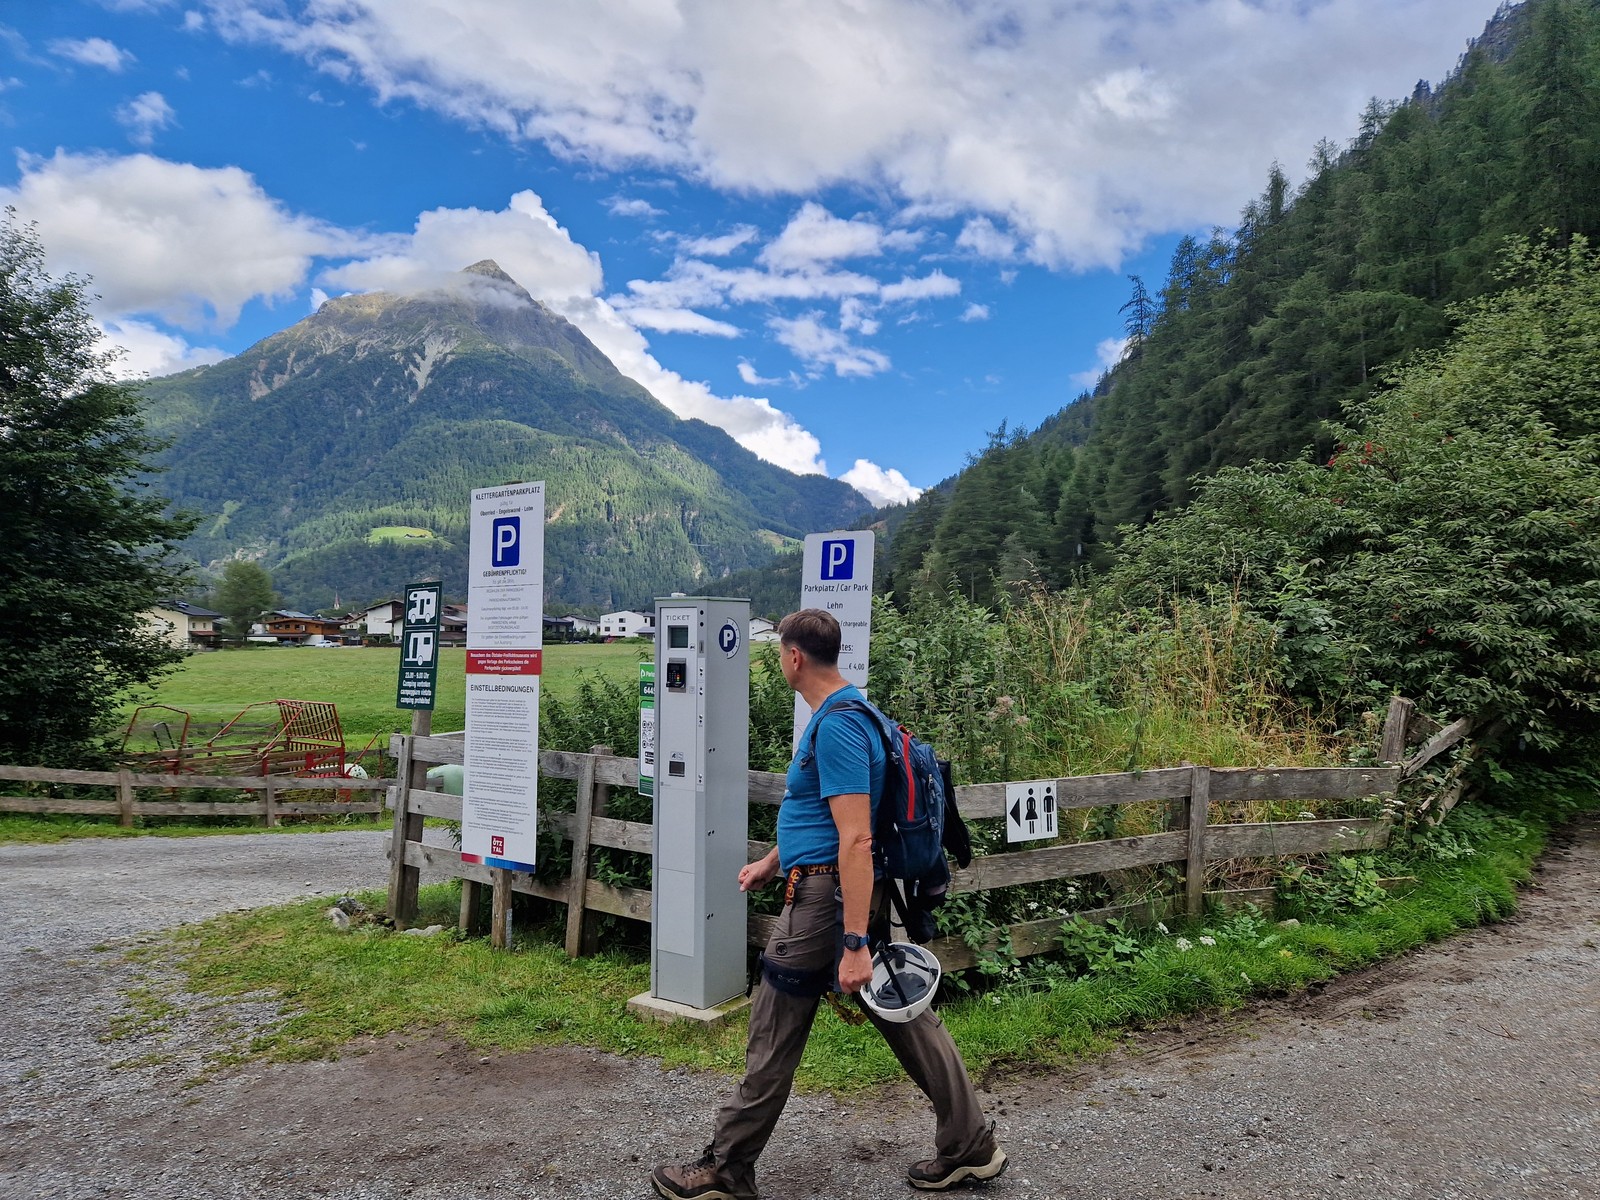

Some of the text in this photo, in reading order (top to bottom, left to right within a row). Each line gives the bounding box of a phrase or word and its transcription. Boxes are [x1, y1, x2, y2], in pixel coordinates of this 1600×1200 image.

[476, 487, 540, 500] KLETTERGARTENPARKPLATZ
[497, 525, 516, 562] P
[829, 543, 846, 577] P
[804, 584, 835, 593] Parkplatz
[723, 630, 734, 647] P
[402, 680, 416, 688] Camping
[471, 685, 534, 693] EINSTELLBEDINGUNGEN
[493, 838, 503, 846] ÖTZ
